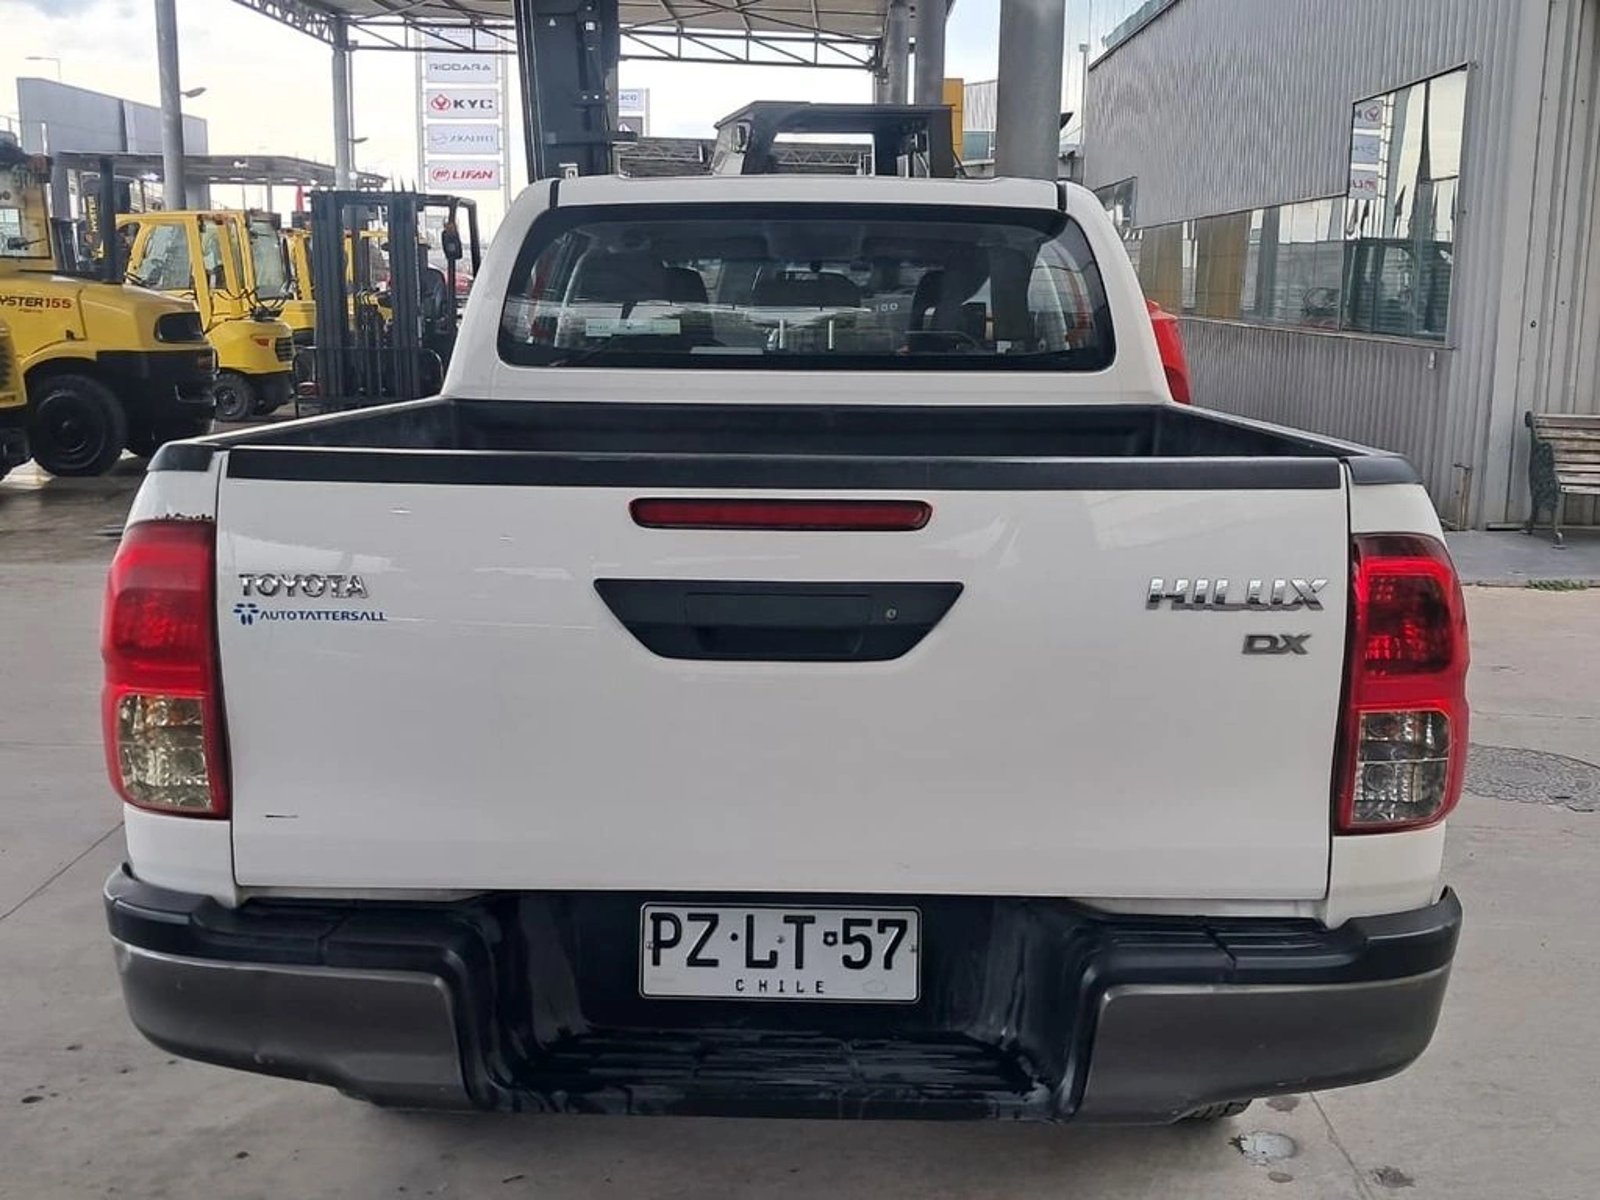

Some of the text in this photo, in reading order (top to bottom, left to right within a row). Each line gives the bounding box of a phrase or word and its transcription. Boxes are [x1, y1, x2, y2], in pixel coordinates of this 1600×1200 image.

[453, 99, 493, 109] KYC
[452, 170, 493, 179] LIFAN
[238, 573, 368, 598] TOYOTA
[1146, 578, 1328, 611] HILUX
[260, 610, 388, 621] AUTOTATTERSALL
[1241, 633, 1312, 655] DX
[735, 979, 824, 993] CHILE
